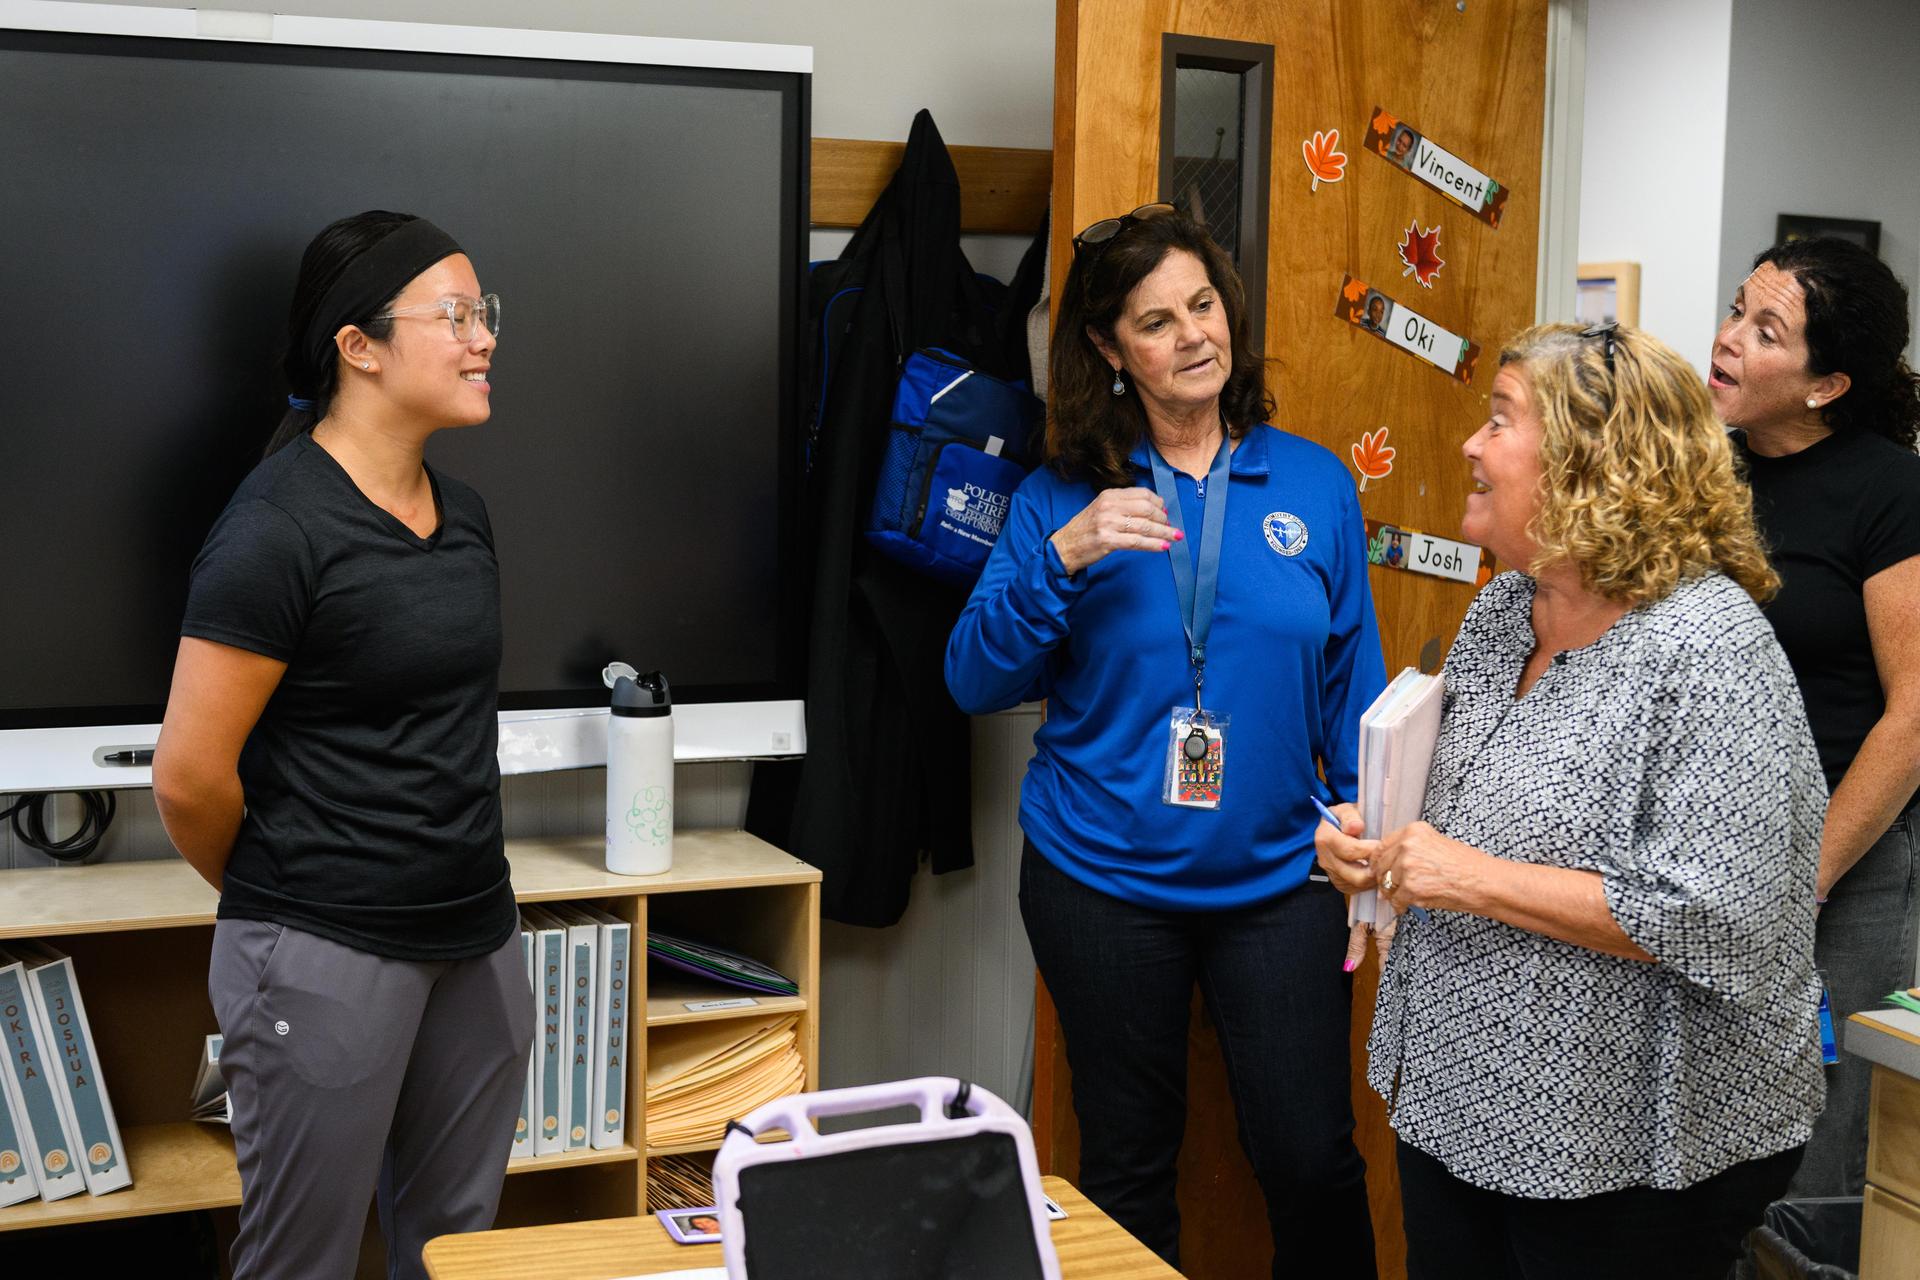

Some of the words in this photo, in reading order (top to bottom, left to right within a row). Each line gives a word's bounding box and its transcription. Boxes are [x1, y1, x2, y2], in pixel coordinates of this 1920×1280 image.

[1419, 144, 1483, 201] Vincent
[1404, 316, 1435, 352] Oki
[963, 482, 1010, 508] POLICE
[976, 500, 1007, 520] FIRE
[965, 508, 1002, 529] FEDERAL
[972, 518, 1000, 536] UNION
[1418, 539, 1462, 573] Josh
[1180, 772, 1215, 783] LOVE
[546, 964, 559, 1055] PENNY
[575, 976, 588, 1066] OKIRA
[610, 959, 624, 1068] JOSHUA
[4, 1004, 37, 1081] OKIRA
[55, 997, 87, 1088] JOSHUA
